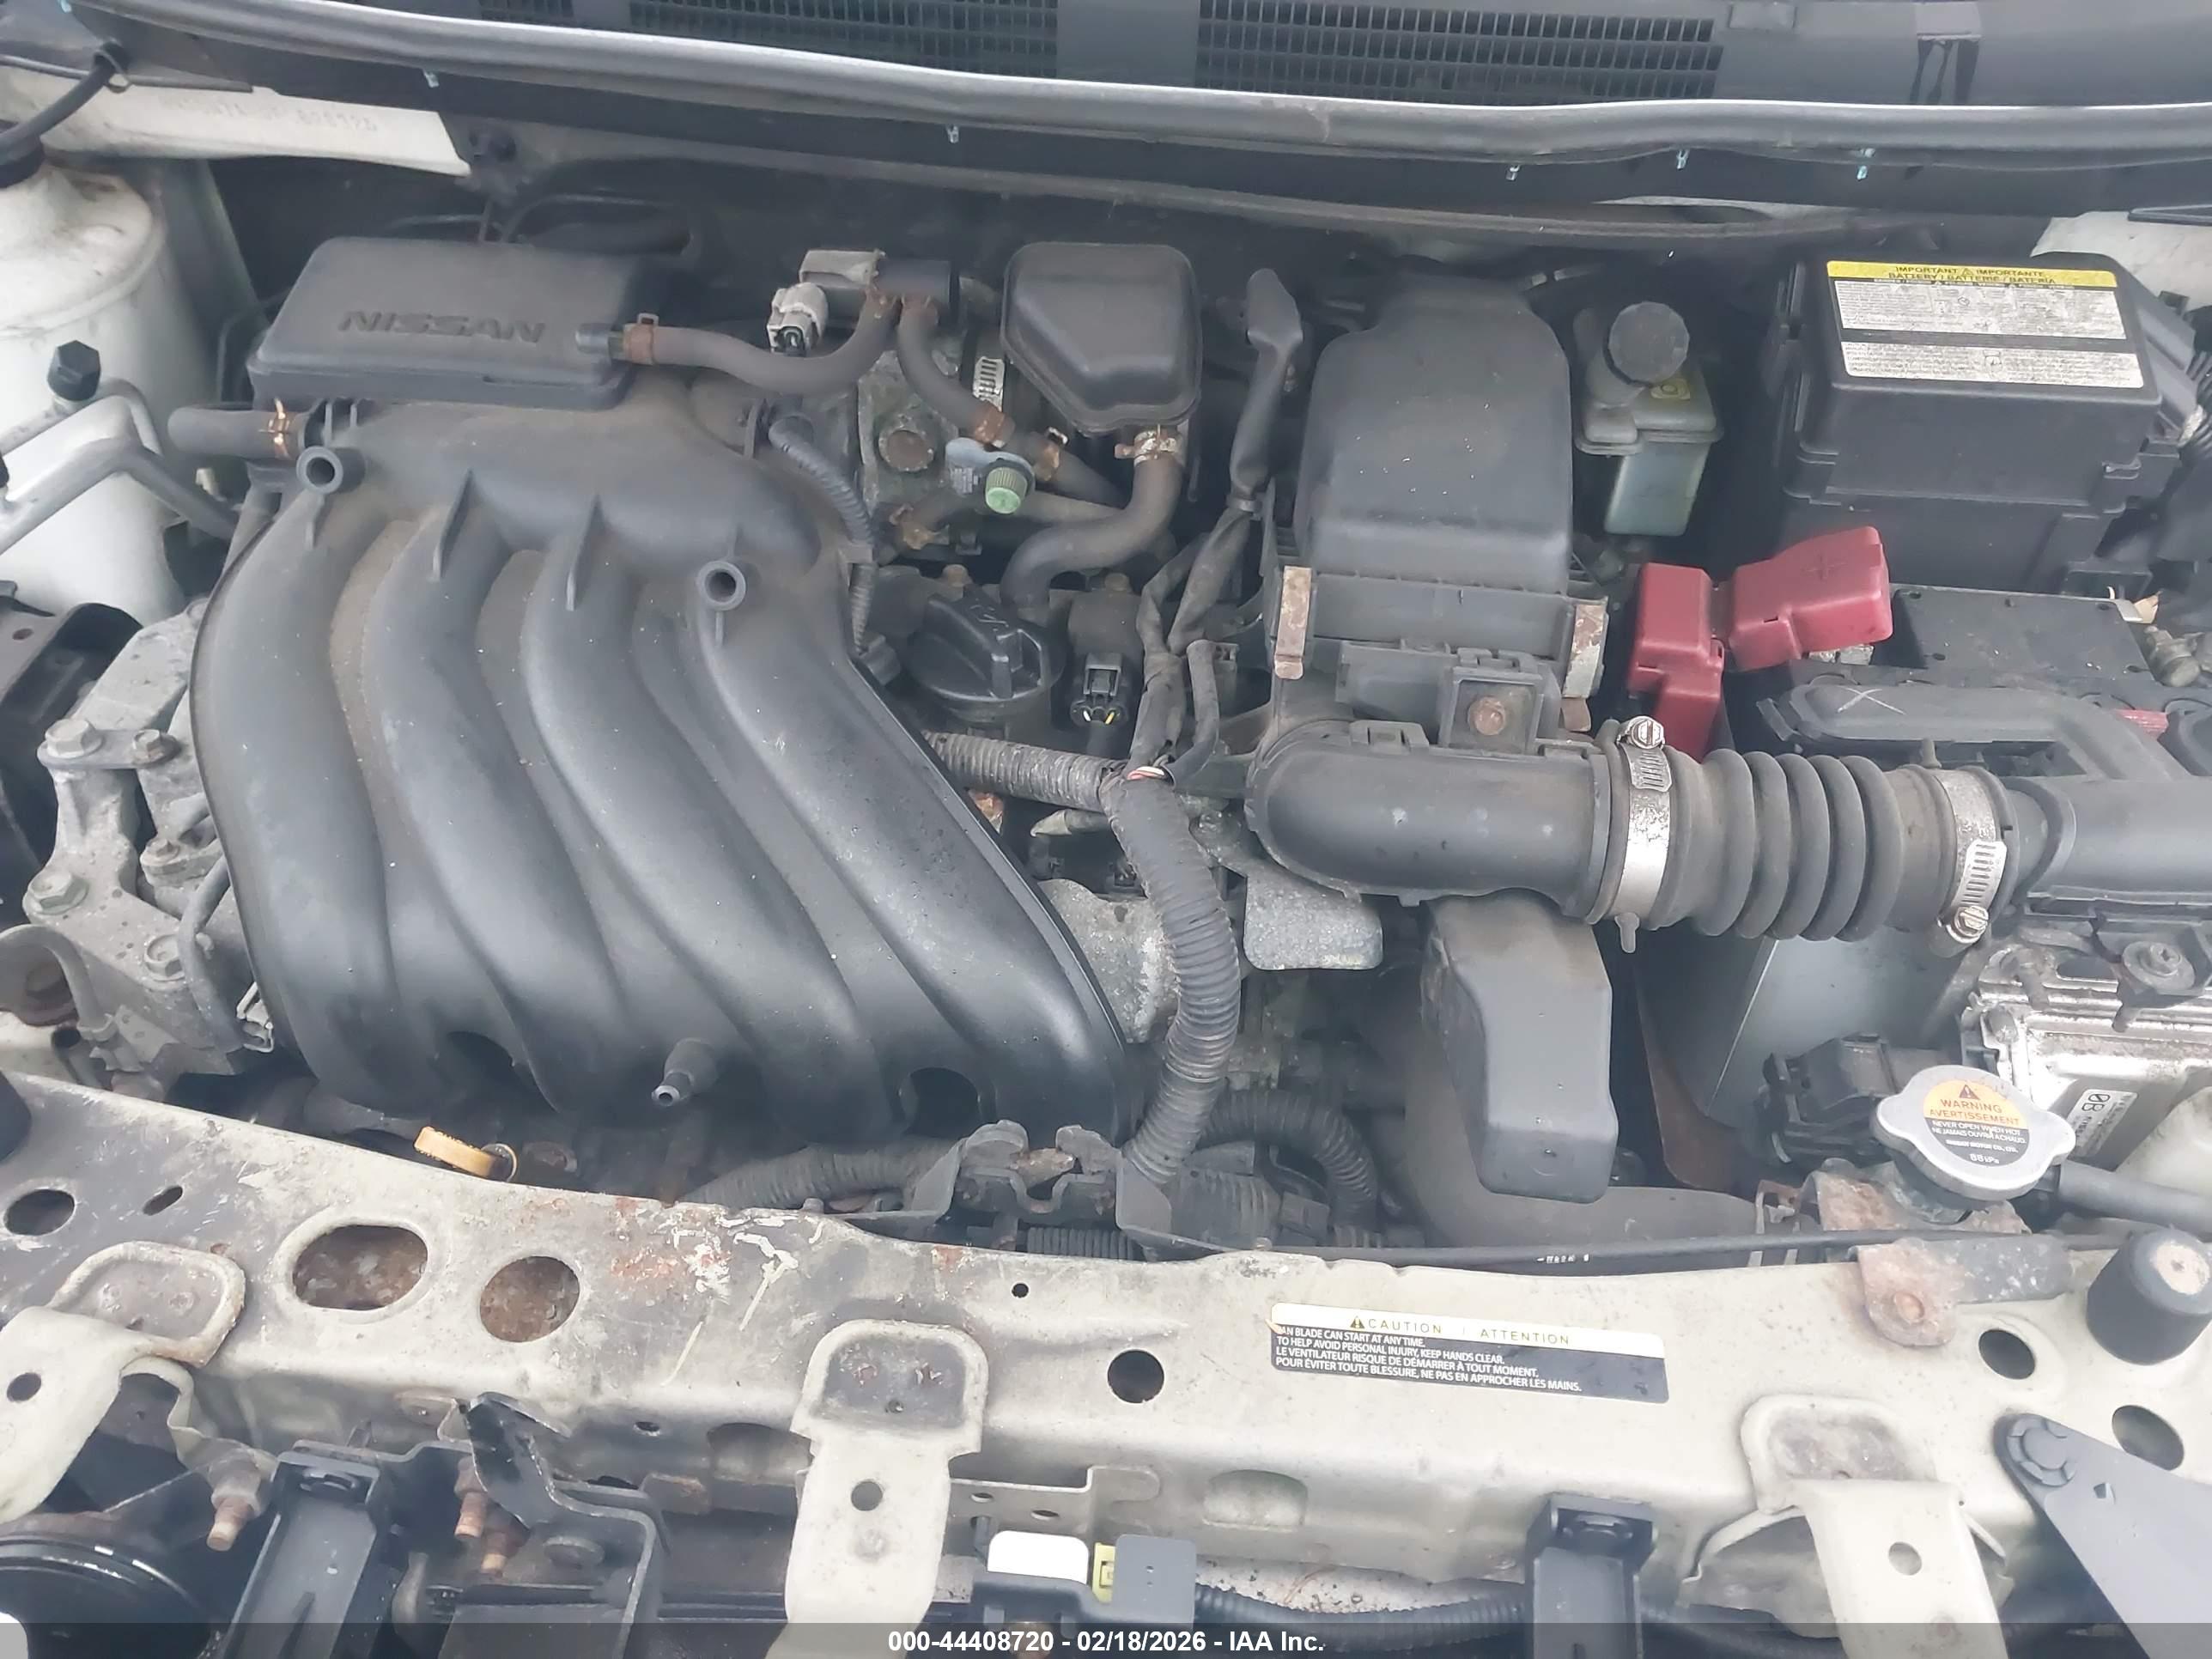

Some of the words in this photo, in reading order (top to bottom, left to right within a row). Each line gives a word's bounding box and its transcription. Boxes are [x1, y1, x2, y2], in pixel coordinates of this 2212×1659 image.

[337, 311, 546, 343] NISSAN
[1929, 1109, 2019, 1125] AVERTISSEMENT
[1941, 1099, 2002, 1113] WARNING
[1932, 1120, 1957, 1128] NEVER
[1295, 1328, 1323, 1339] BLADE
[1323, 1330, 1343, 1340] CAN
[1344, 1332, 1370, 1343] START
[1371, 1334, 1382, 1344] AT
[1382, 1335, 1402, 1346] ANY
[1401, 1337, 1426, 1348] TIME.
[1368, 1318, 1443, 1334] CAUTION
[1480, 1328, 1570, 1346] ATTENTION
[1276, 1346, 1288, 1356] LE
[1288, 1347, 1352, 1361] VENTILATEUR
[1352, 1352, 1388, 1365] RISQUE
[1388, 1357, 1403, 1366] DE
[1465, 1364, 1492, 1374] TOUT
[1492, 1365, 1539, 1378] MOMENT.
[1277, 1336, 1290, 1346] TO
[1291, 1337, 1312, 1348] HELP
[1313, 1340, 1341, 1351] AVOID
[1341, 1342, 1388, 1354] PERSONAL
[1388, 1346, 1420, 1358] INJURY,
[1420, 1349, 1443, 1359] KEEP
[1443, 1351, 1474, 1362] HANDS
[1474, 1353, 1505, 1364] CLEAR.
[1276, 1357, 1304, 1368] POUR
[1337, 1362, 1370, 1374] TOUTE
[1370, 1364, 1420, 1380] BLESSURE,
[1420, 1370, 1436, 1380] NE
[1435, 1371, 1455, 1382] PAS
[1455, 1374, 1469, 1382] EN
[1469, 1375, 1528, 1388] APPROCHER
[1529, 1379, 1547, 1389] LES
[1547, 1381, 1583, 1393] MAINS.
